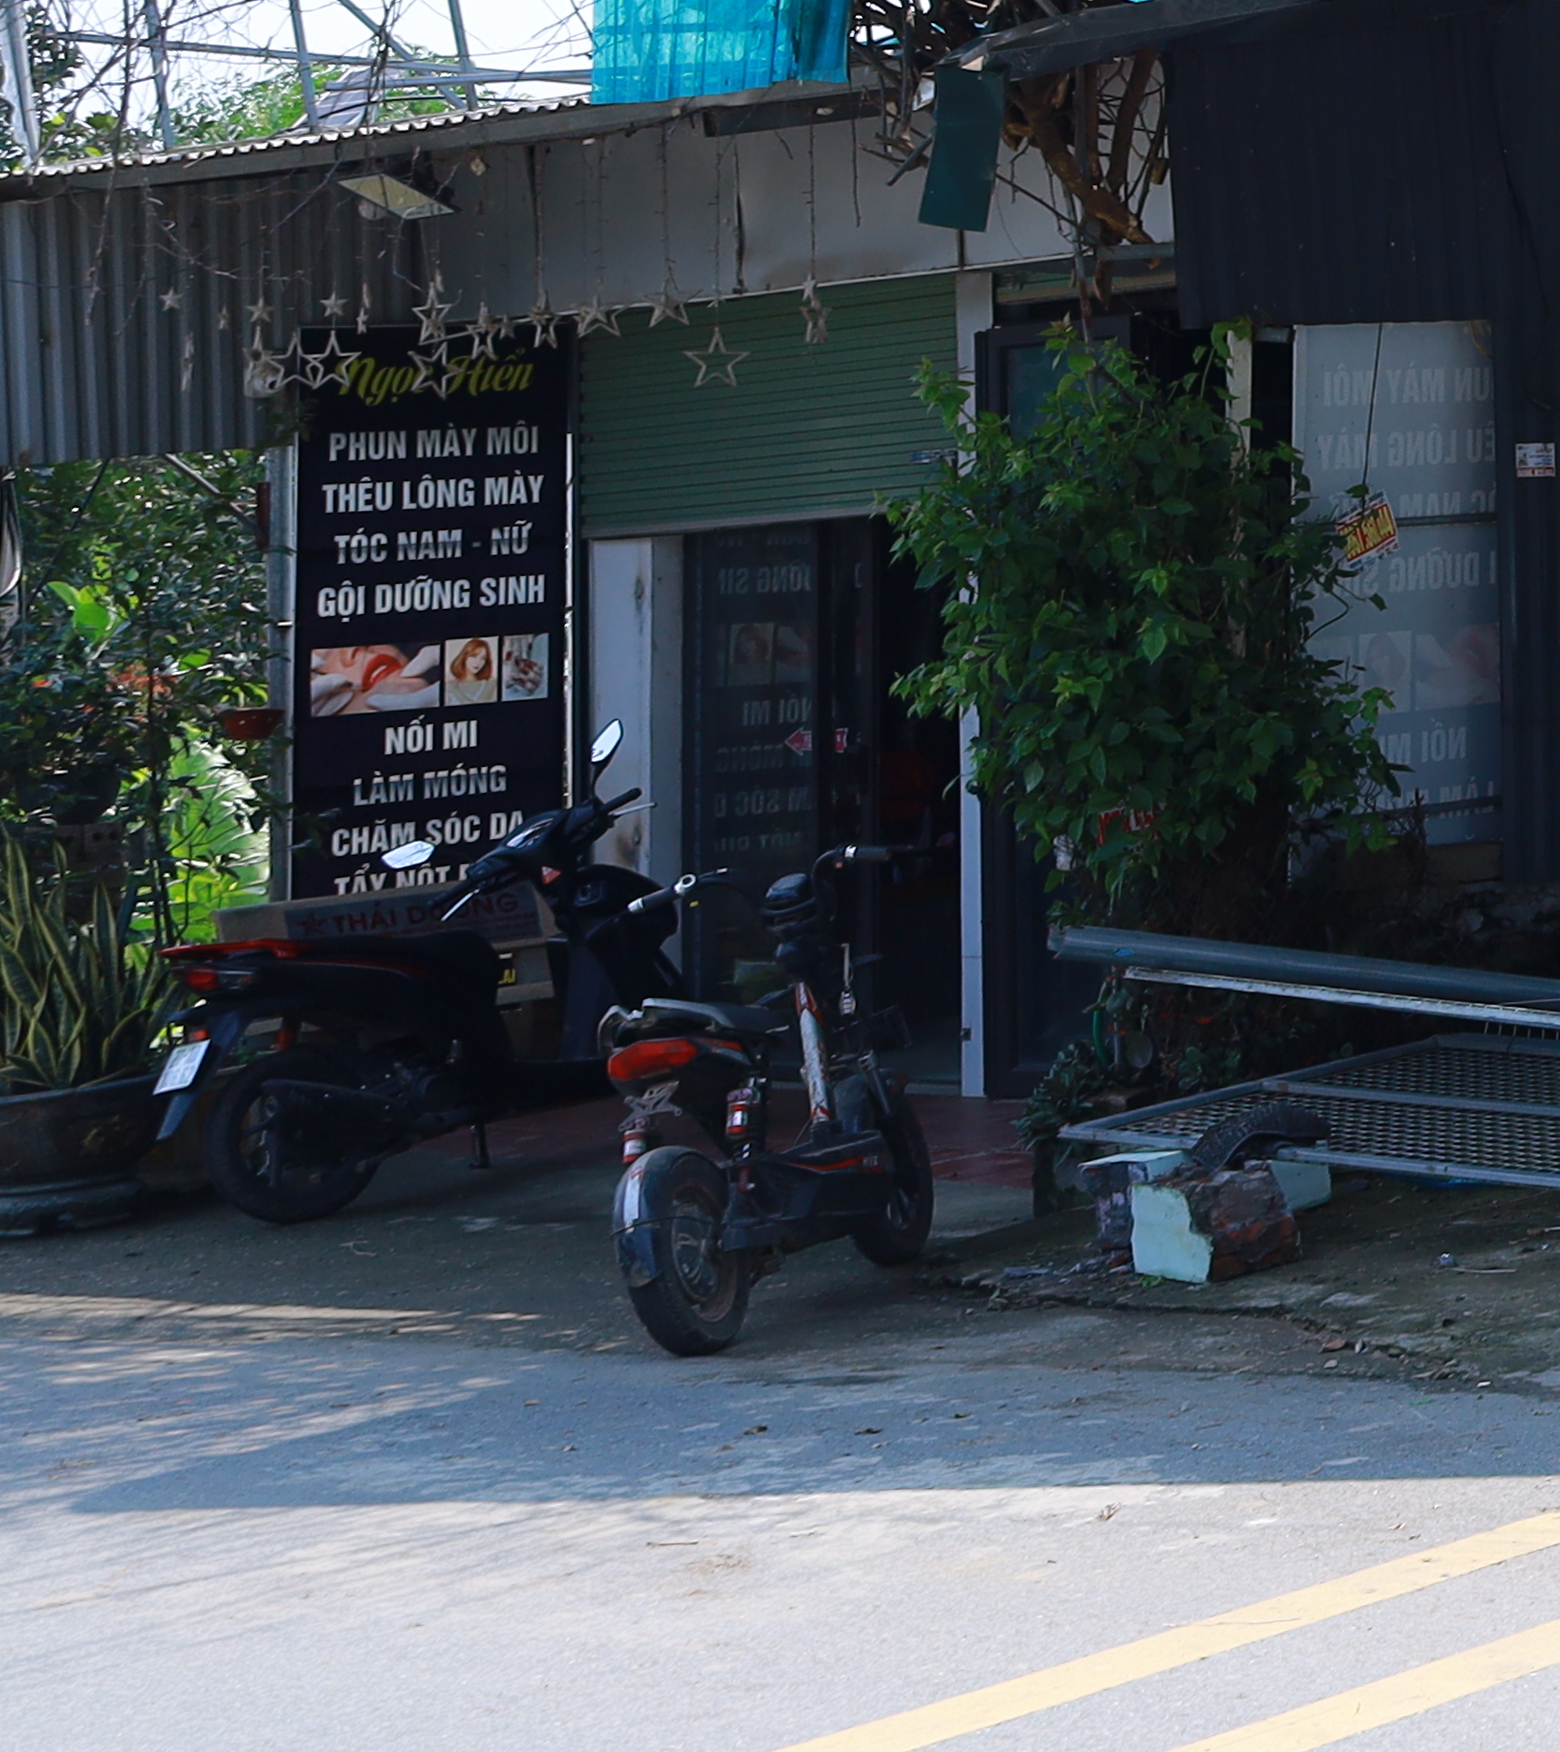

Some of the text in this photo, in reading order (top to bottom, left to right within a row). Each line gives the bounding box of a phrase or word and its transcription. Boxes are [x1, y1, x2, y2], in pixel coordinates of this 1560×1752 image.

[329, 420, 539, 462] PHUN MÀY MÔI
[321, 470, 545, 514] THÊU LÔNG MÀY
[333, 528, 388, 565] TÓC
[396, 528, 463, 561] NAM
[490, 520, 533, 556] NỮ
[317, 574, 545, 623] GỘI DƯỠNG SINH
[384, 715, 478, 755] NỐI MI
[353, 763, 507, 806] LÀM MÓNG
[331, 818, 417, 857] CHĂM
[425, 810, 481, 846] SÓC
[328, 901, 396, 933] THÁI
